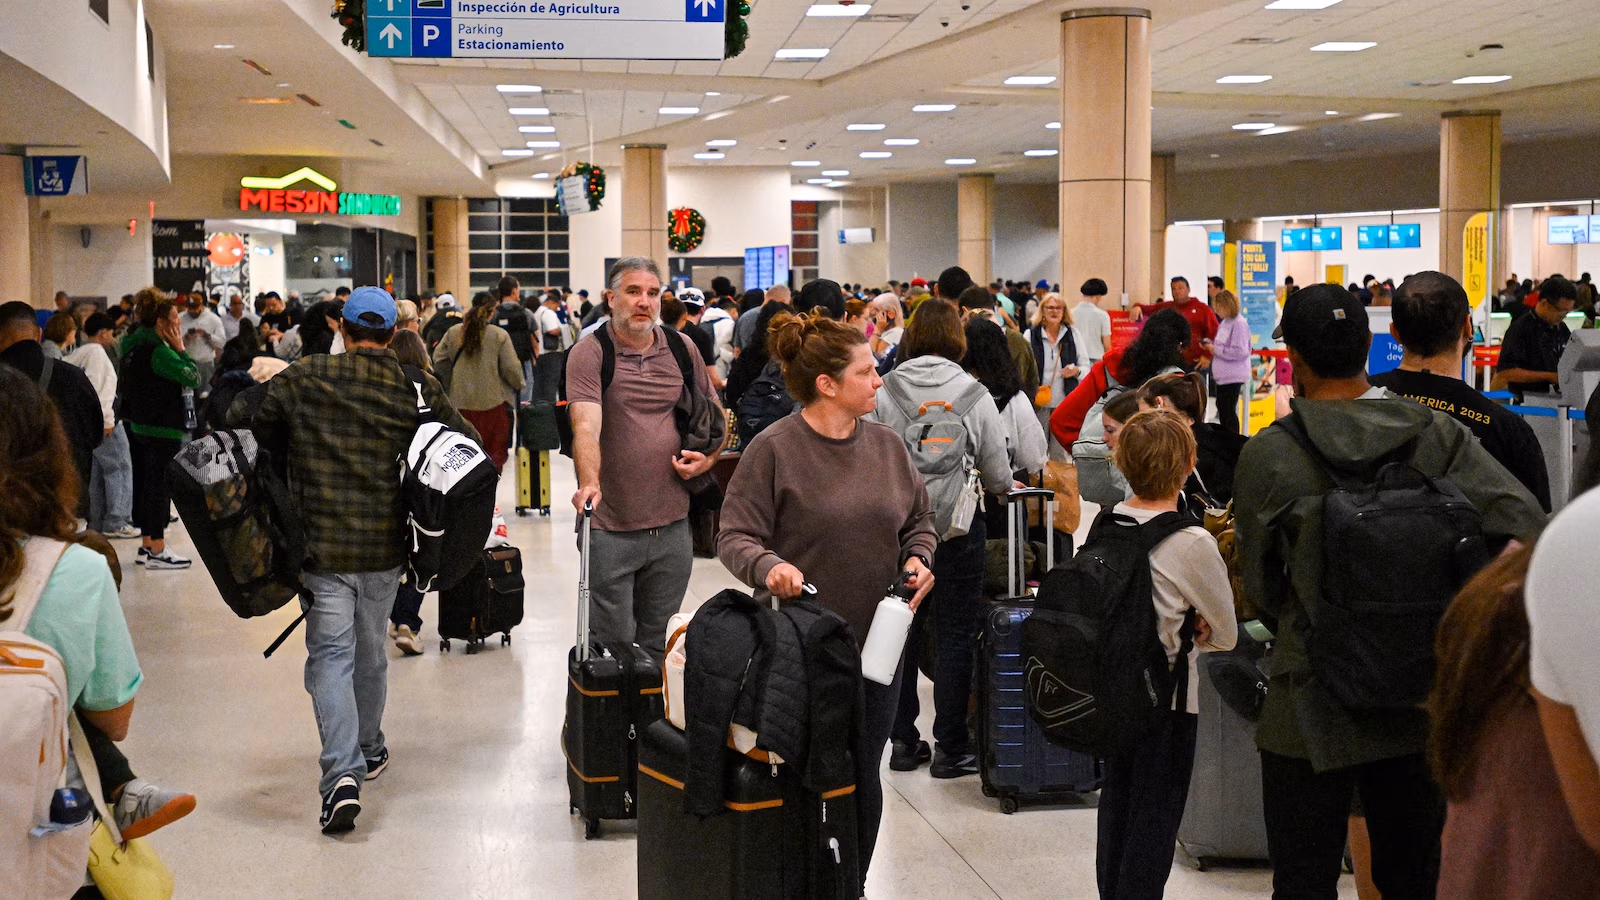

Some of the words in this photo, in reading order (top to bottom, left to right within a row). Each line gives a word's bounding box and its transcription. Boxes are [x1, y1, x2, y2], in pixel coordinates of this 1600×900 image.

[458, 1, 526, 15] Inspección
[530, 2, 545, 13] de
[548, 3, 620, 16] Agricultura
[423, 24, 440, 47] P
[458, 23, 504, 37] Parking
[458, 38, 565, 51] Estacionamiento
[1459, 406, 1491, 425] 2023
[442, 446, 459, 459] THE
[440, 450, 465, 473] NORTH
[451, 455, 470, 473] FACE
